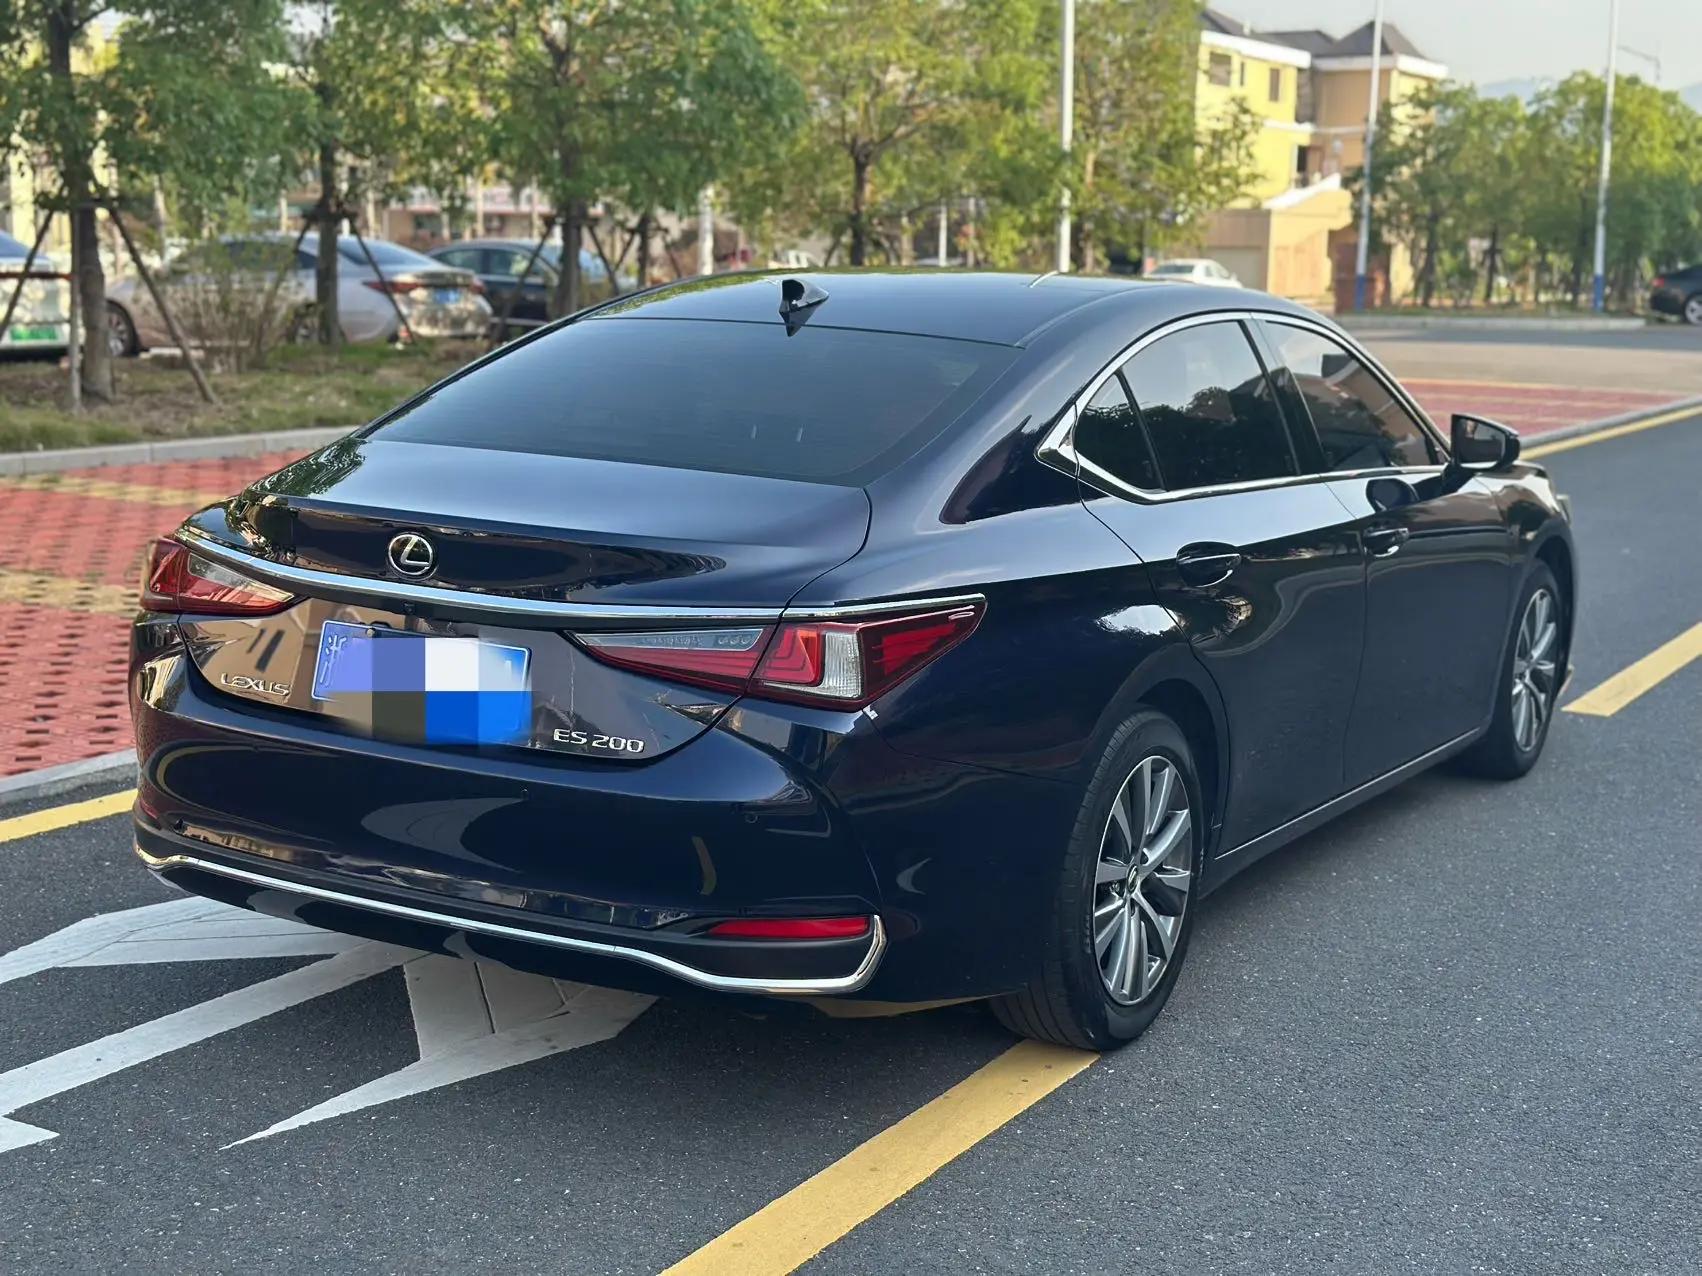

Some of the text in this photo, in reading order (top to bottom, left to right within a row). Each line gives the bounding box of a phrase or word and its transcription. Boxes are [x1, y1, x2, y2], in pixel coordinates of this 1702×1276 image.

[220, 672, 290, 696] LEXUS
[553, 728, 645, 753] ES 200
